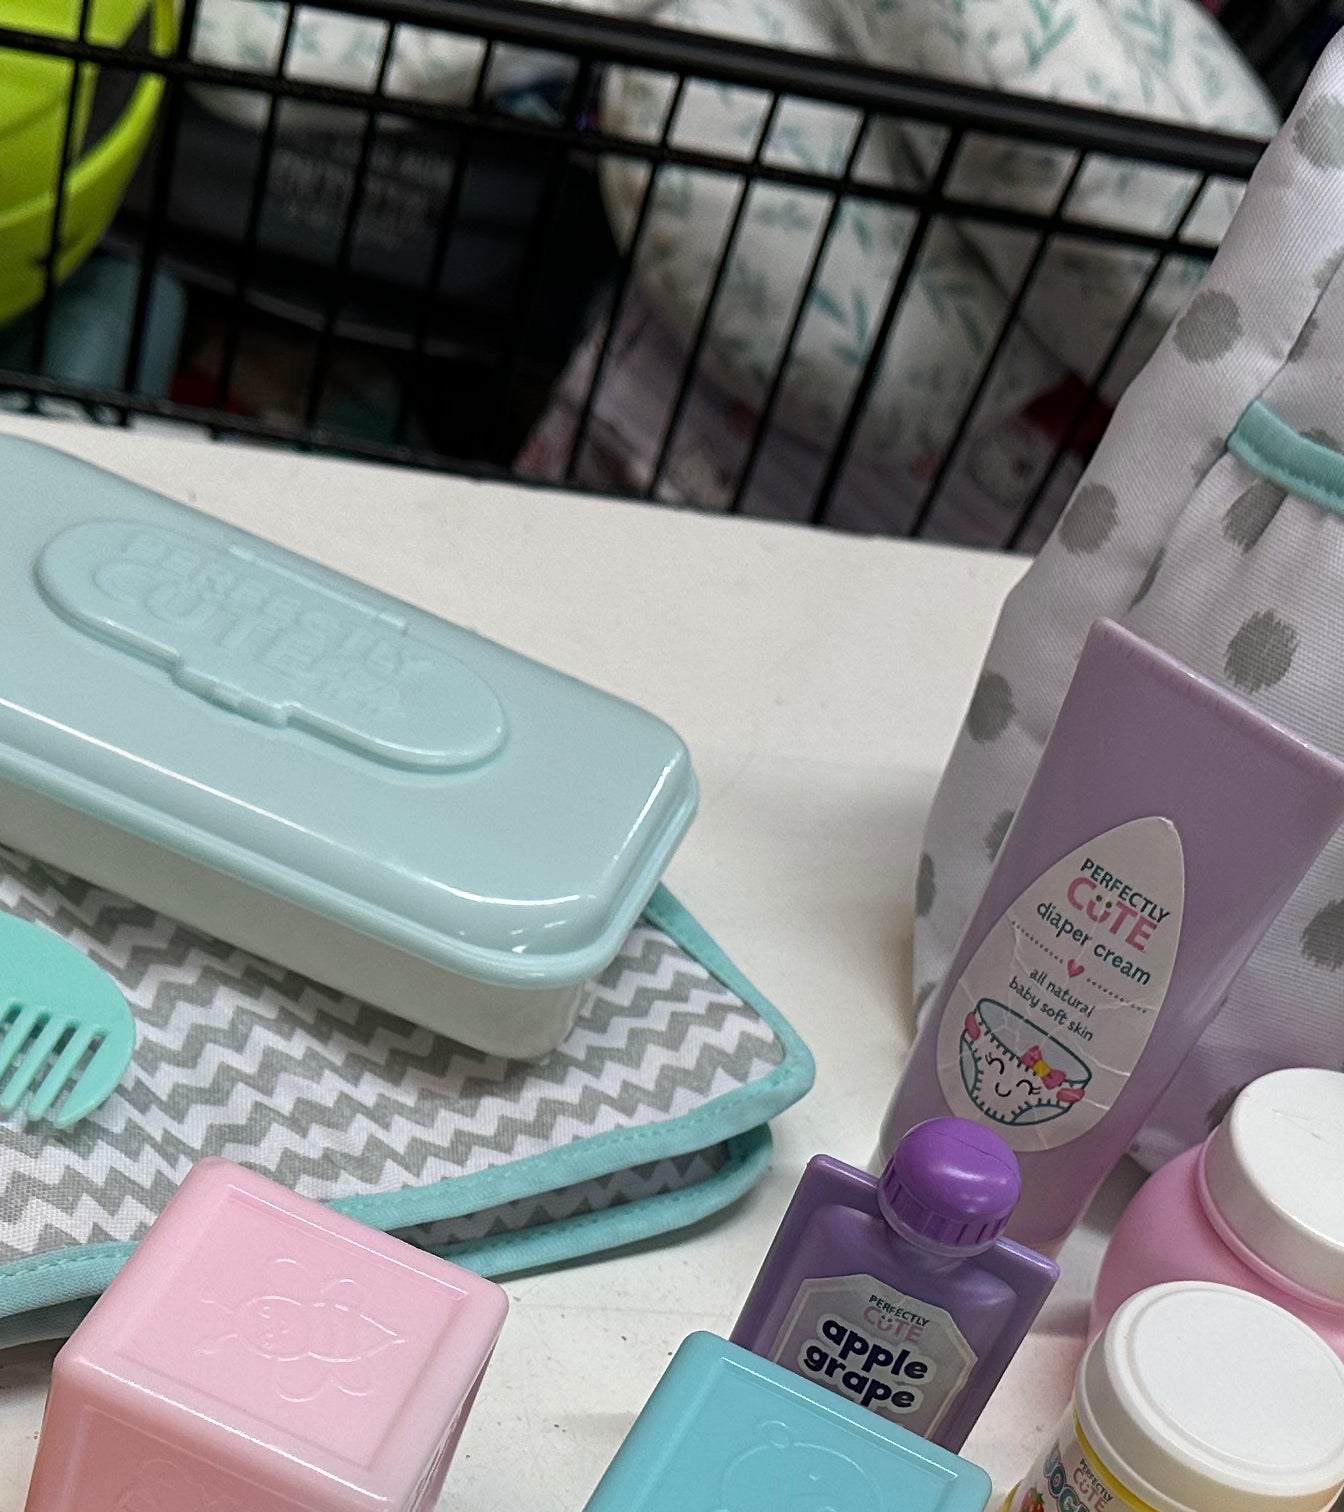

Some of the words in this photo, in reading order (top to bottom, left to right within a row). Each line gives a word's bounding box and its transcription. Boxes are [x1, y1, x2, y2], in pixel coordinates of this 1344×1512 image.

[1080, 857, 1171, 924] PERFECTLY
[1036, 901, 1092, 947] diaper
[1093, 943, 1151, 986] cream
[1009, 975, 1040, 1008] baby
[1040, 1000, 1068, 1026] soft
[1067, 1018, 1094, 1042] skin
[1029, 967, 1047, 986] all
[1047, 979, 1096, 1018] natural
[868, 1294, 930, 1327] PERFECTLY
[803, 1343, 916, 1408] grape
[822, 1319, 928, 1380] apple
[1079, 1457, 1114, 1502] PERFECTLY
